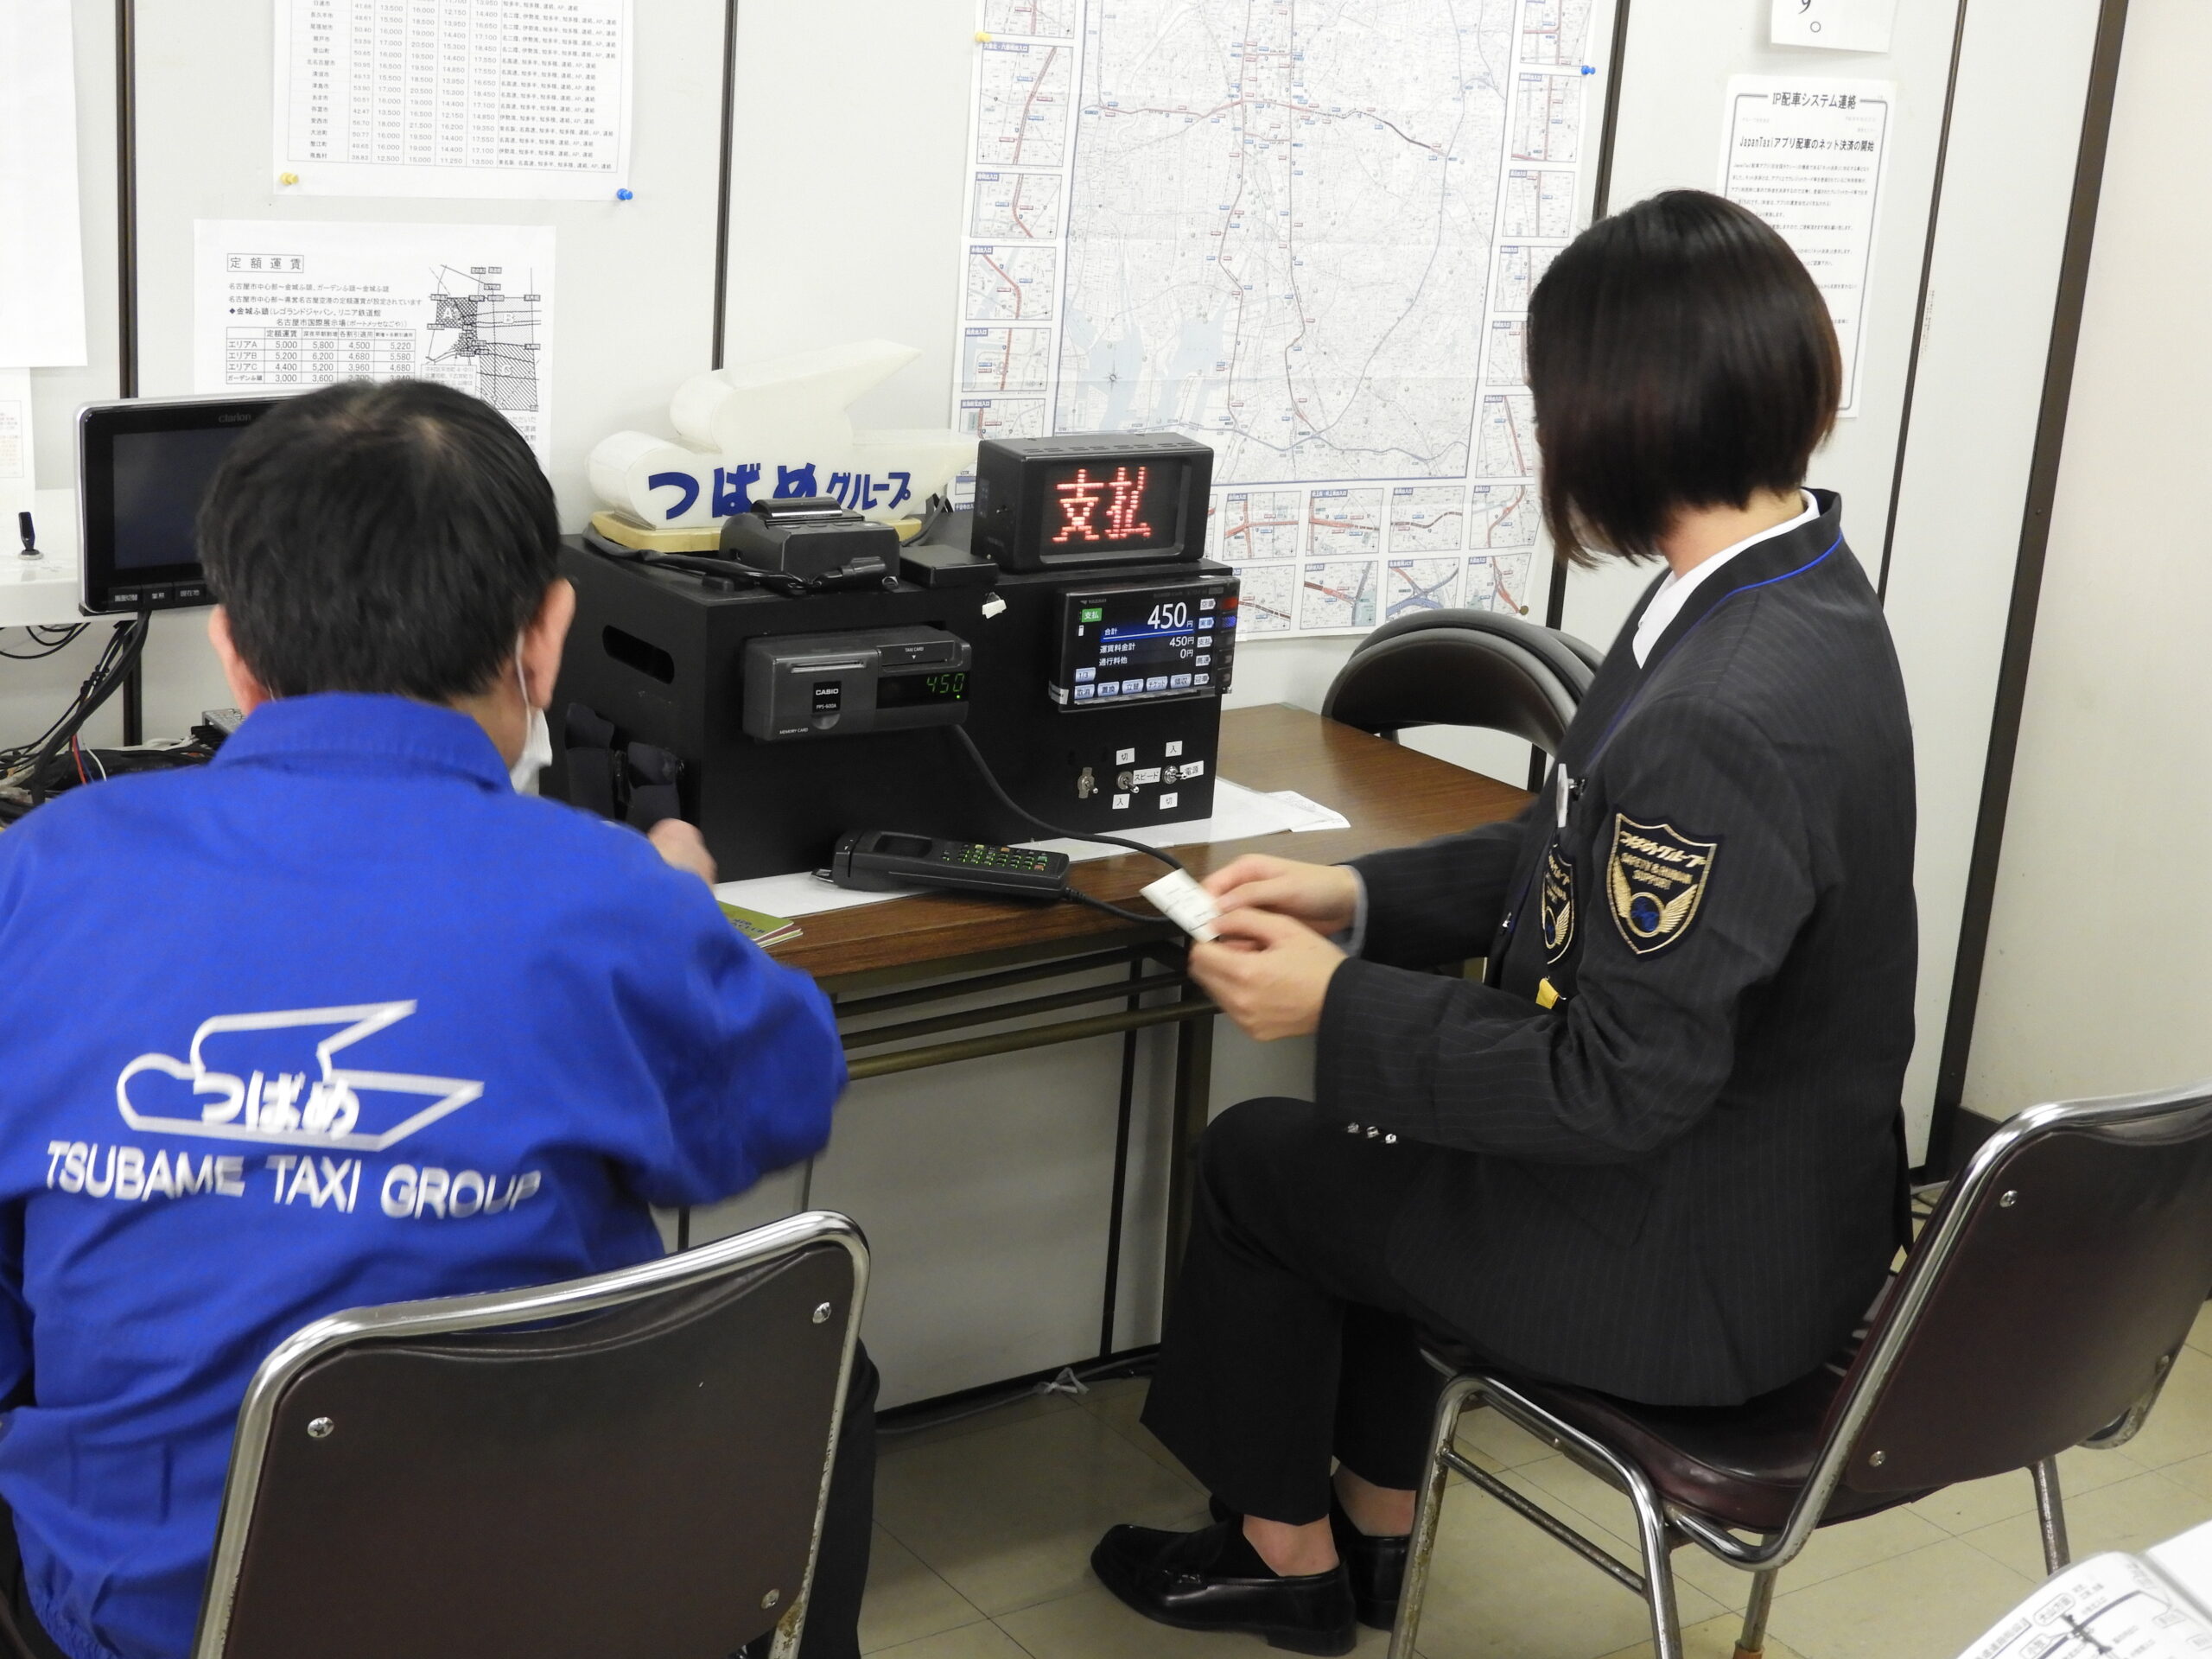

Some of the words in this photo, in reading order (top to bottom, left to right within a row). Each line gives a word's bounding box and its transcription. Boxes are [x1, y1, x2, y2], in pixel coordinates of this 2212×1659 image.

[1772, 91, 1857, 110] IP配車システム連絡
[266, 329, 298, 338] 定額運賃
[276, 340, 297, 349] 5,000
[312, 341, 334, 350] 5,800
[348, 341, 370, 350] 4,500
[276, 352, 297, 360] 5,200
[312, 352, 334, 360] 6,200
[348, 353, 370, 361] 4,680
[390, 353, 411, 361] 5,580
[276, 363, 297, 372] 4,400
[312, 363, 334, 372] 5,200
[348, 364, 370, 372] 3,960
[390, 364, 411, 372] 4,680
[312, 374, 334, 383] 3,600
[1052, 466, 1152, 543] 支払
[1084, 611, 1099, 620] 支払
[1104, 627, 1118, 636] 合計
[1098, 656, 1128, 666] 通行料他
[926, 673, 964, 694] 450
[1126, 683, 1140, 691] 立替
[1121, 753, 1128, 761] 切
[1135, 771, 1160, 781] スピード
[193, 1070, 360, 1141] つばめ
[47, 1140, 245, 1202] TSUBAME
[264, 1154, 361, 1214] TAXI
[380, 1164, 542, 1220] GROUP
